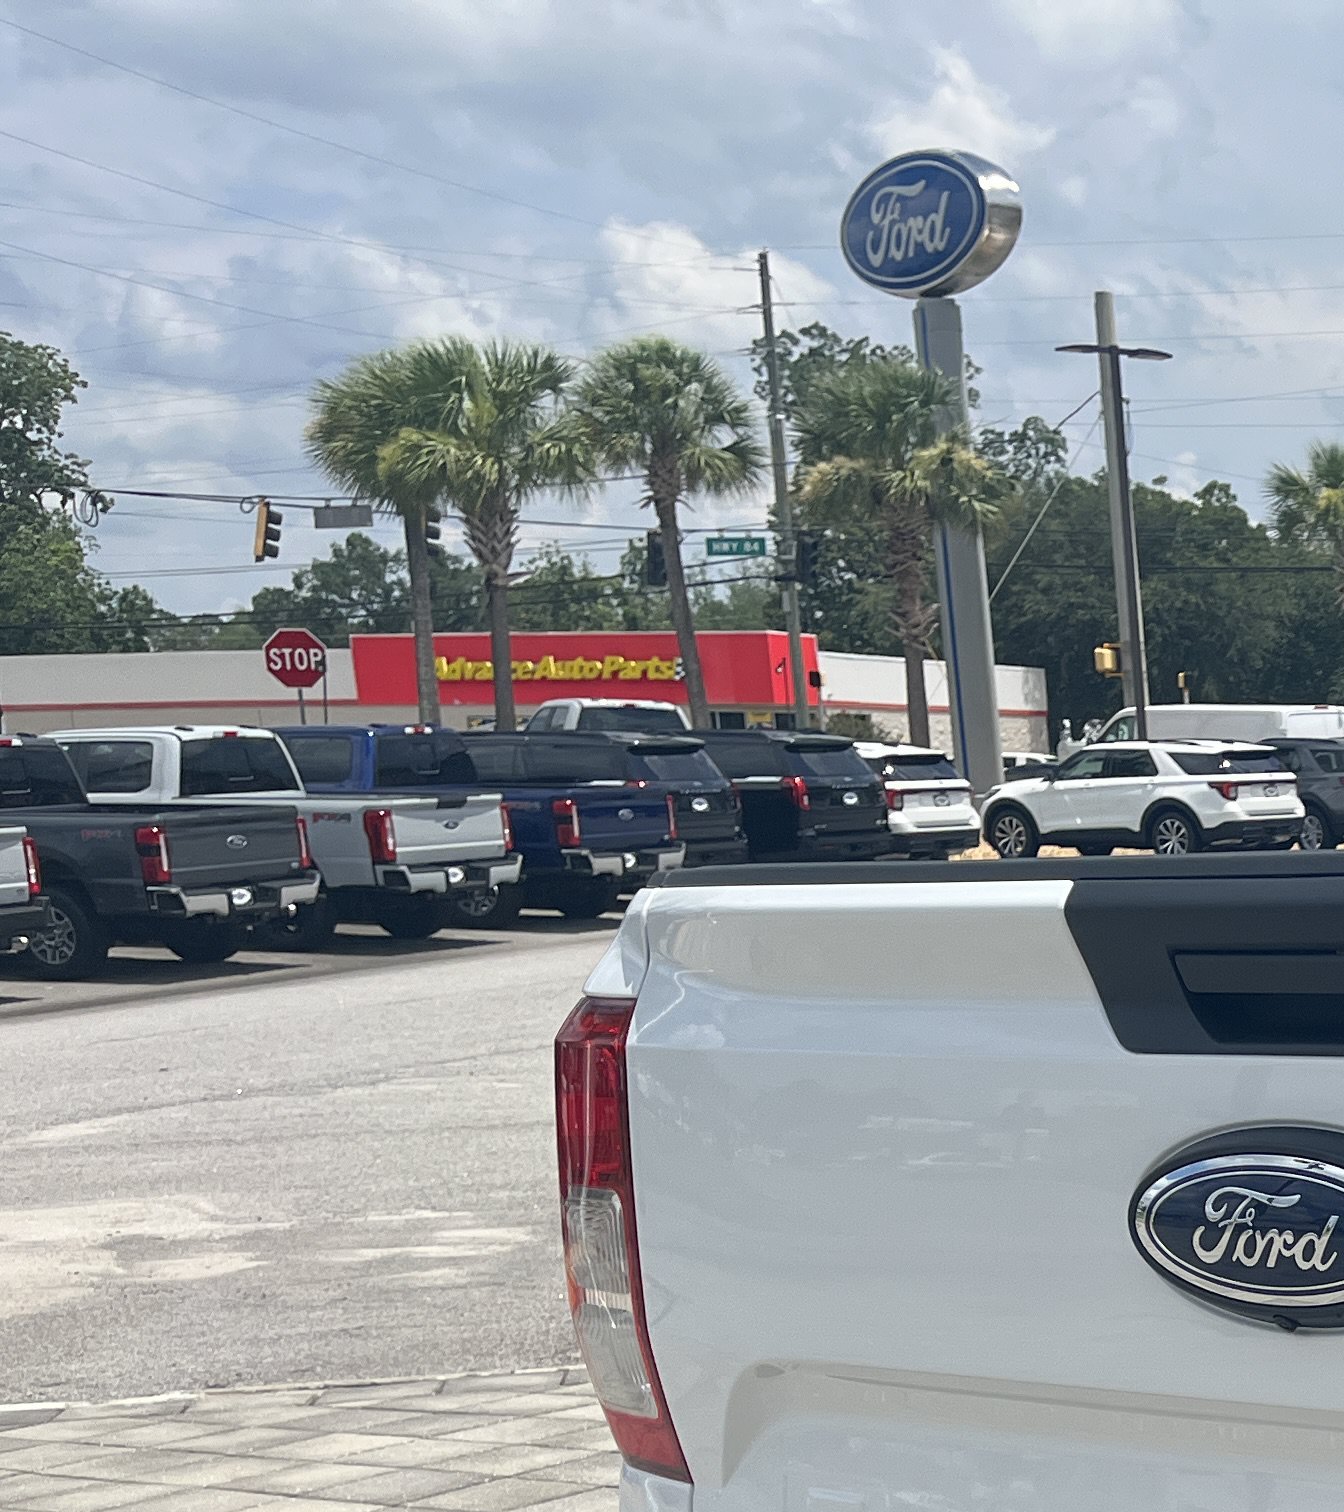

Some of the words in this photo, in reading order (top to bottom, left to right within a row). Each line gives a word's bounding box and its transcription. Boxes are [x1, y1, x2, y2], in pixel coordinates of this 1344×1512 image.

[866, 179, 951, 267] Ford
[269, 647, 323, 671] STOP
[435, 656, 534, 680] Advace
[534, 655, 603, 680] Auto
[602, 655, 676, 680] Parts
[1193, 1186, 1340, 1272] Ford
